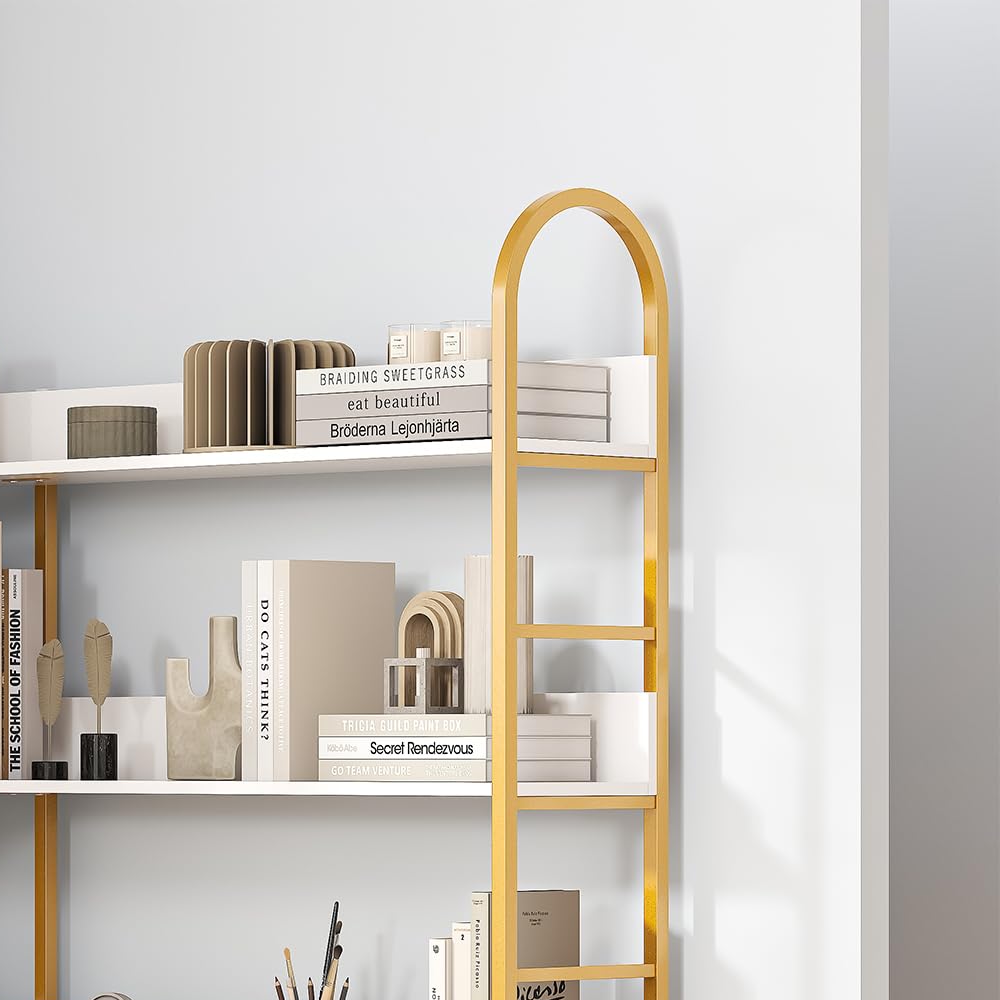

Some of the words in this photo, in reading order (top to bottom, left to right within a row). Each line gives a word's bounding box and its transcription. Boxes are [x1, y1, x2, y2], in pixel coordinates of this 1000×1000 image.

[320, 368, 378, 387] BRAIDING
[383, 364, 466, 385] SWEETGRASS
[347, 398, 369, 411] eat
[375, 391, 441, 409] beautiful
[330, 420, 386, 438] Bröderna
[391, 416, 460, 438] Lejonhjärta
[260, 599, 270, 623] DO
[10, 608, 21, 666] FASHION
[260, 630, 270, 672] CATS
[10, 669, 21, 688] OF
[10, 689, 21, 744] SCHOOL
[260, 678, 270, 741] THINK?
[413, 719, 440, 732] PAINT
[443, 719, 463, 732] BOX
[10, 746, 21, 772] THE
[370, 741, 406, 755] Secret
[407, 741, 474, 755] Rendezvous
[331, 765, 344, 777] GO
[346, 765, 369, 776] TEAM
[371, 764, 412, 776] VENTURE
[460, 933, 465, 941] 2
